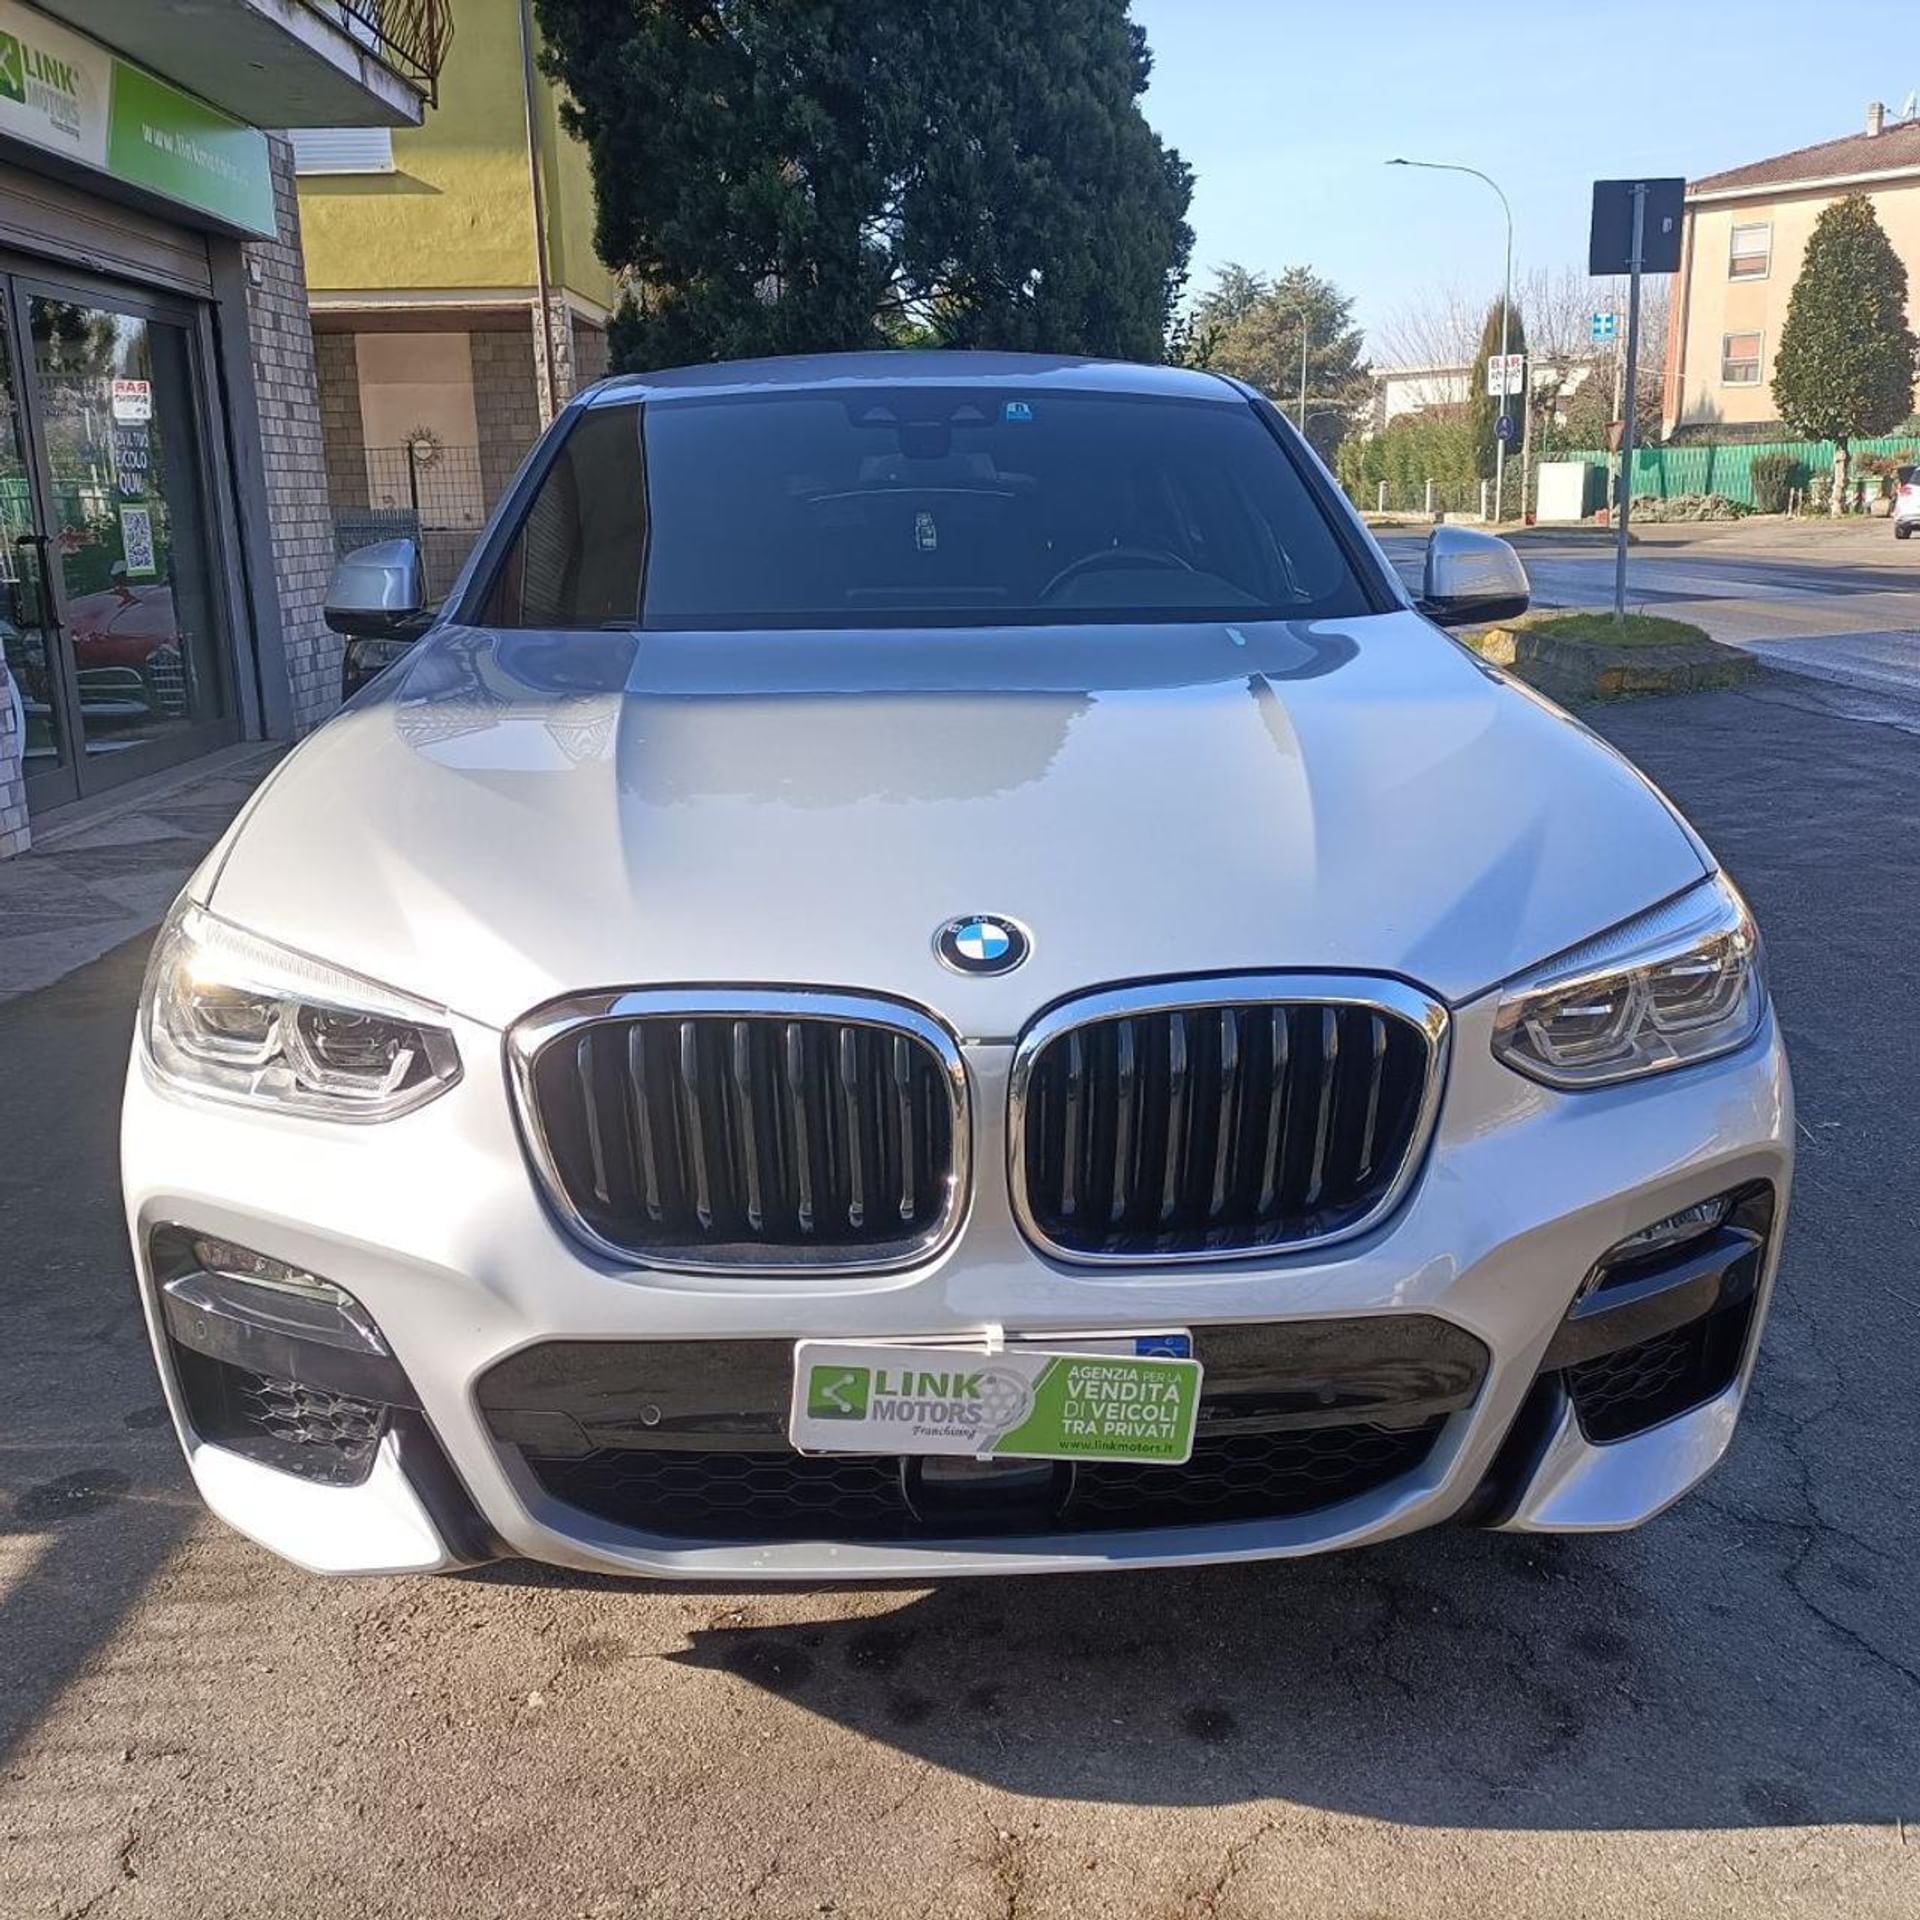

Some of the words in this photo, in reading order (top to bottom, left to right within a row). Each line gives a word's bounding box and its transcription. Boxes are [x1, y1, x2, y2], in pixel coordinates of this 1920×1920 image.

[21, 43, 77, 97] LINK
[874, 1369, 985, 1400] LINK
[1068, 1364, 1139, 1382] AGENZIA
[1143, 1371, 1165, 1383] PER
[1167, 1372, 1183, 1384] LA
[1066, 1379, 1181, 1404] VENDITA
[872, 1399, 983, 1425] MOTORS
[1063, 1400, 1086, 1418] DI
[1091, 1401, 1179, 1423] VEICOLI
[1061, 1418, 1099, 1436] TRA
[1103, 1420, 1176, 1439] PRIVATI
[1058, 1440, 1174, 1454] www.linkmotors.it
